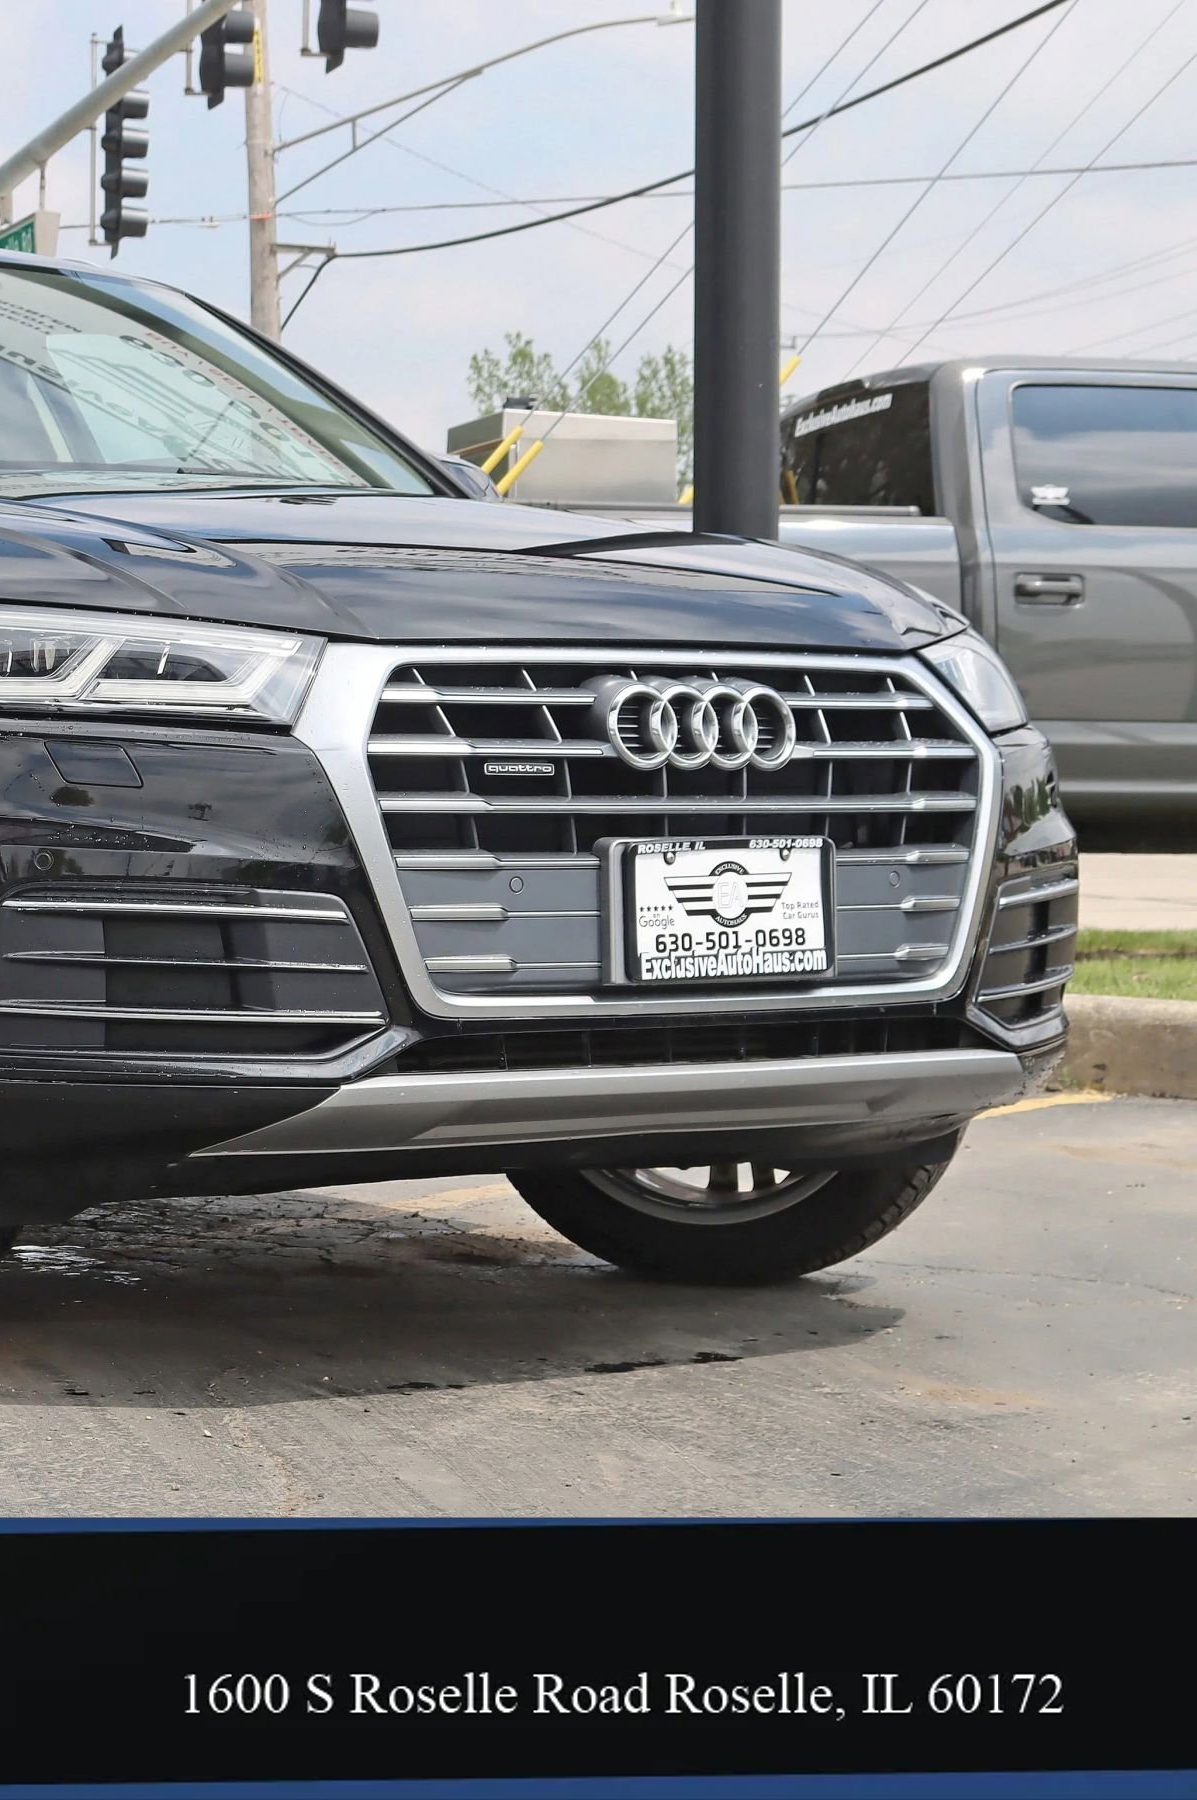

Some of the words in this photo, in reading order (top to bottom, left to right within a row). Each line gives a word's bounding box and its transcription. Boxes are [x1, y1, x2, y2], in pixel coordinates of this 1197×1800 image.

[487, 764, 552, 773] quattro
[694, 840, 706, 851] IL
[749, 838, 824, 849] 630-501-0698
[714, 862, 745, 876] EXCLUSIVE
[717, 880, 744, 909] EA
[781, 901, 795, 911] Top
[796, 901, 820, 909] Rated
[638, 914, 675, 930] Google
[714, 913, 748, 927] AUTOHAUS
[782, 912, 796, 920] Car
[797, 911, 820, 919] Gurus
[655, 927, 806, 953] 630-501-0698
[641, 949, 828, 981] ExclusiveAutoHaus.com
